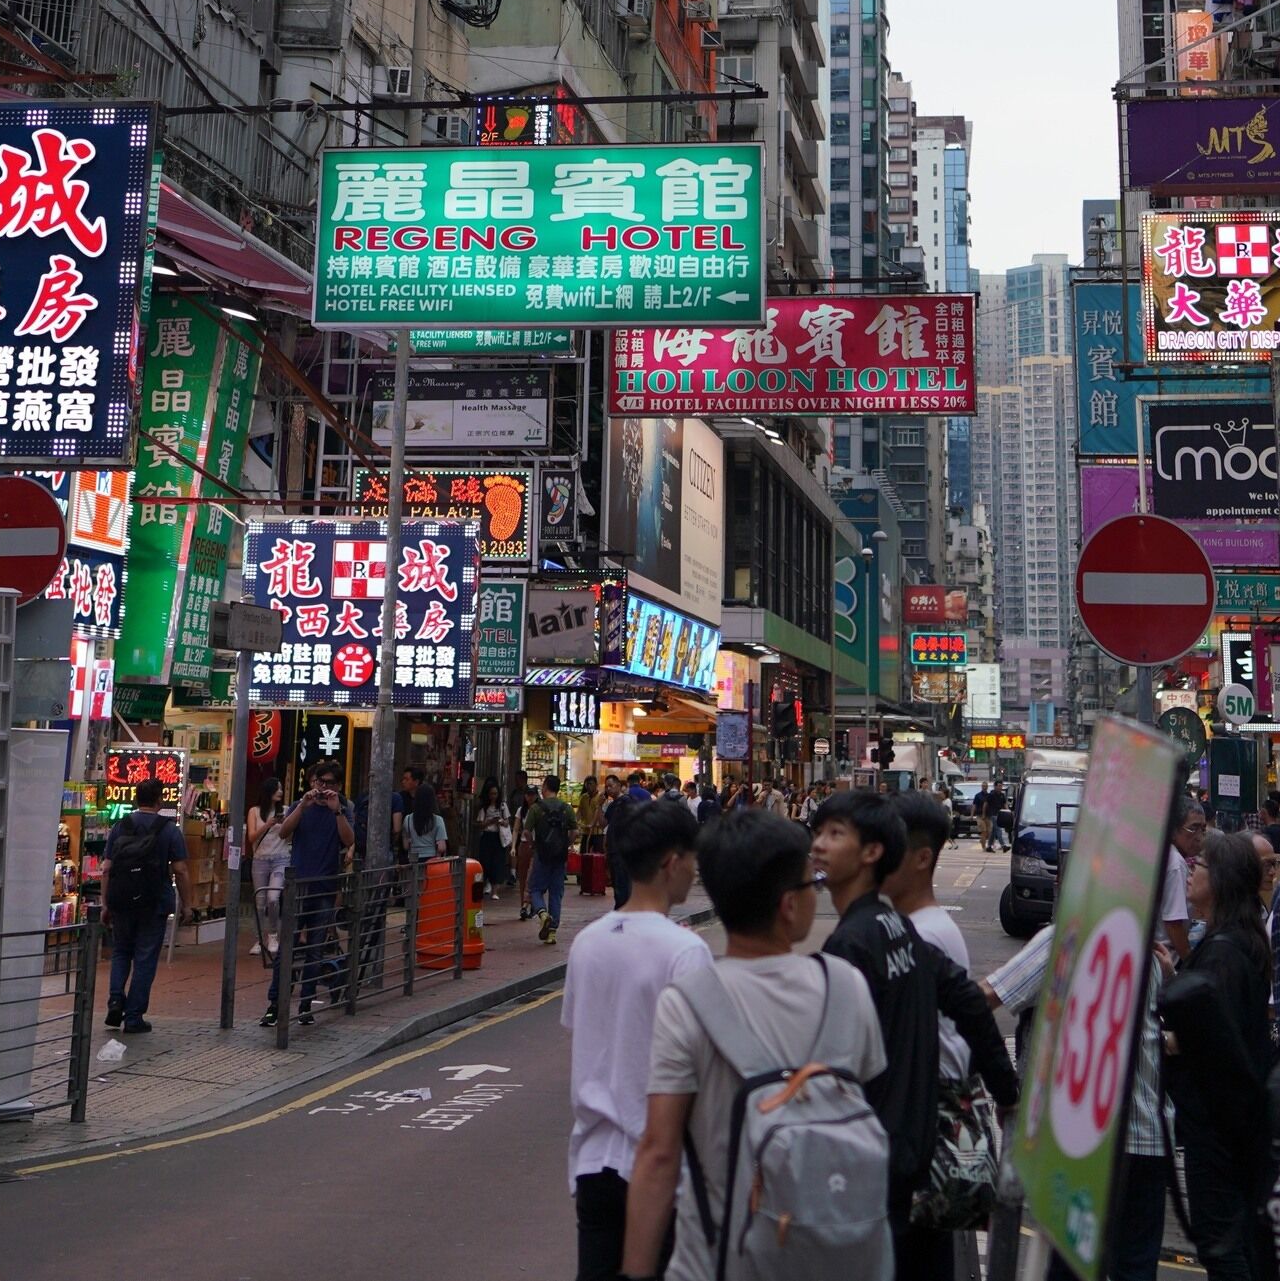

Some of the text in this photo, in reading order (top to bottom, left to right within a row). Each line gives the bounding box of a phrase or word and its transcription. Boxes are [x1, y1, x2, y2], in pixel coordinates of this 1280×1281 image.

[481, 132, 499, 142] 2/F
[330, 157, 754, 224] 麗晶賓館
[332, 224, 747, 253] REGENG HOTEL
[1155, 225, 1216, 277] 龍
[326, 254, 751, 280] 持牌賓館 酒店設備 豪華套房 歡迎自由行
[325, 284, 517, 297] HOTEL FACILITY LIENSED
[525, 284, 635, 311] 免費wifi上網
[325, 299, 453, 312] HOTEL FREE WIFI
[416, 331, 473, 340] FACILITY LIENSED
[654, 303, 929, 368] 海龍賓館
[936, 302, 950, 363] 全日特平
[951, 302, 966, 366] 時租過夜
[1158, 331, 1218, 350] DRAGON
[1218, 331, 1249, 350] CITY
[416, 340, 448, 349] FREE WIFI
[423, 376, 466, 389] Massage
[615, 367, 967, 393] HOI LOON HOTEL
[461, 404, 527, 412] Health Massage
[650, 396, 967, 411] HOTEL FACILITEIS OVER NIGHT LESS 20%
[138, 317, 196, 527] 麗晶賓館
[527, 428, 543, 436] 1/F
[688, 447, 716, 502] CITIZEN
[1249, 492, 1263, 500] We
[411, 506, 483, 519] PALACE
[1206, 507, 1271, 517] appointment
[194, 537, 227, 560] REGENG
[490, 541, 523, 555] 2093
[1204, 538, 1264, 548] KING BUILDING
[260, 539, 458, 602] 龍 城
[480, 588, 517, 624] 館
[252, 663, 332, 687] 免稅正貨
[342, 660, 365, 683] 正
[493, 666, 515, 674] WIFI
[1225, 694, 1253, 717] 5M
[319, 724, 343, 757] ¥
